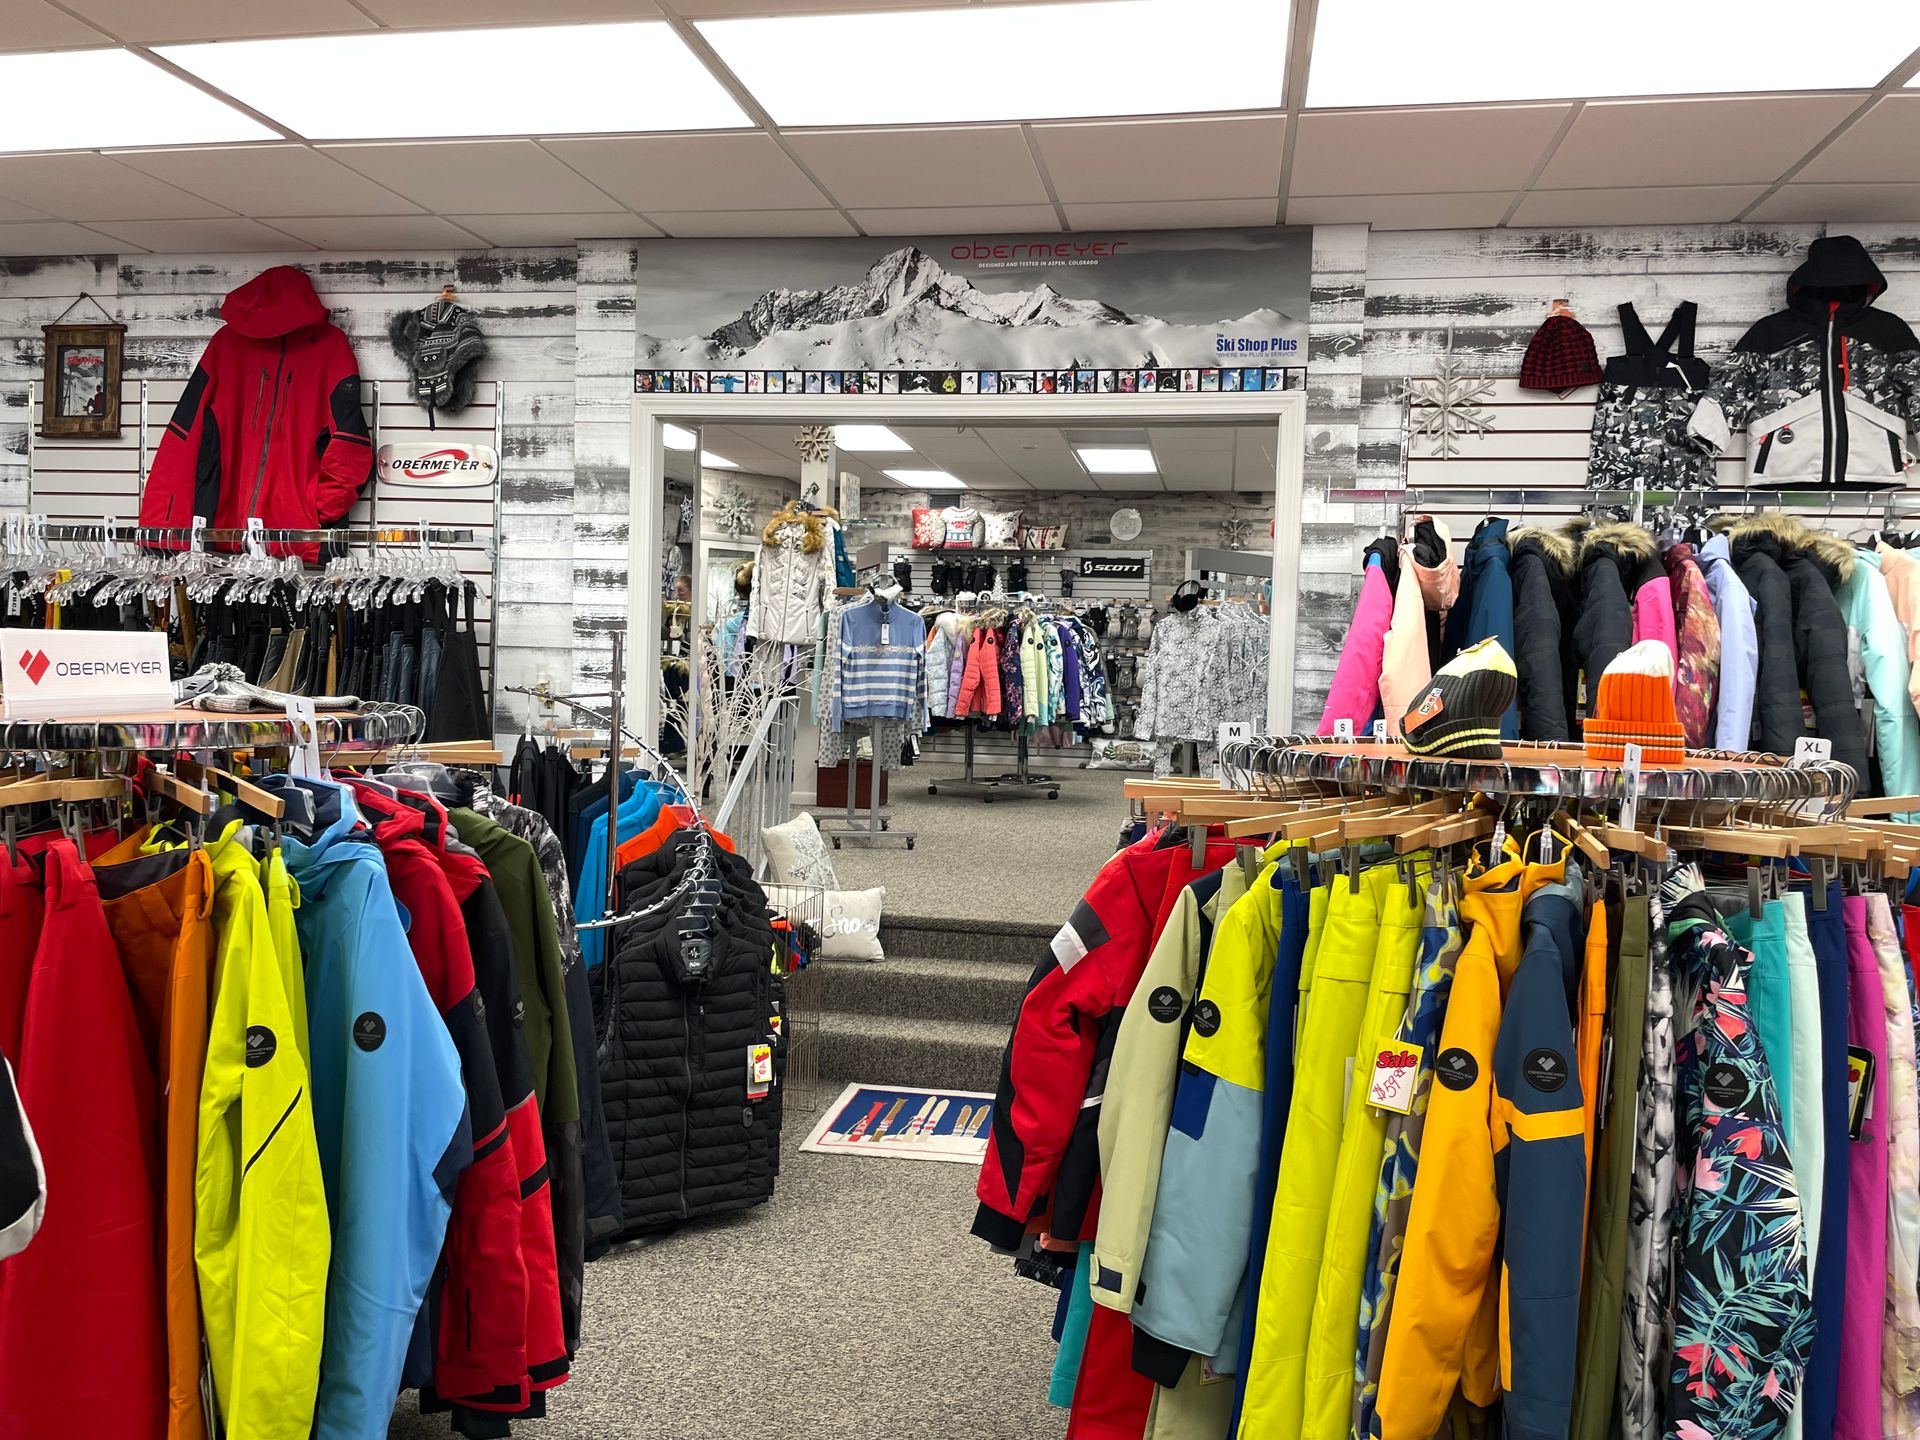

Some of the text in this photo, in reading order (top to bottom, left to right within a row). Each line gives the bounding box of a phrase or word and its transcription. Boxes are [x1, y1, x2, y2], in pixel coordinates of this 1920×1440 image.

[1216, 337, 1298, 352] Ski Shop Plus
[392, 460, 480, 470] OBERMEYER
[56, 661, 162, 677] OBERMEYER
[1229, 727, 1241, 737] M
[1804, 741, 1823, 753] XL
[1376, 1051, 1418, 1068] Sale
